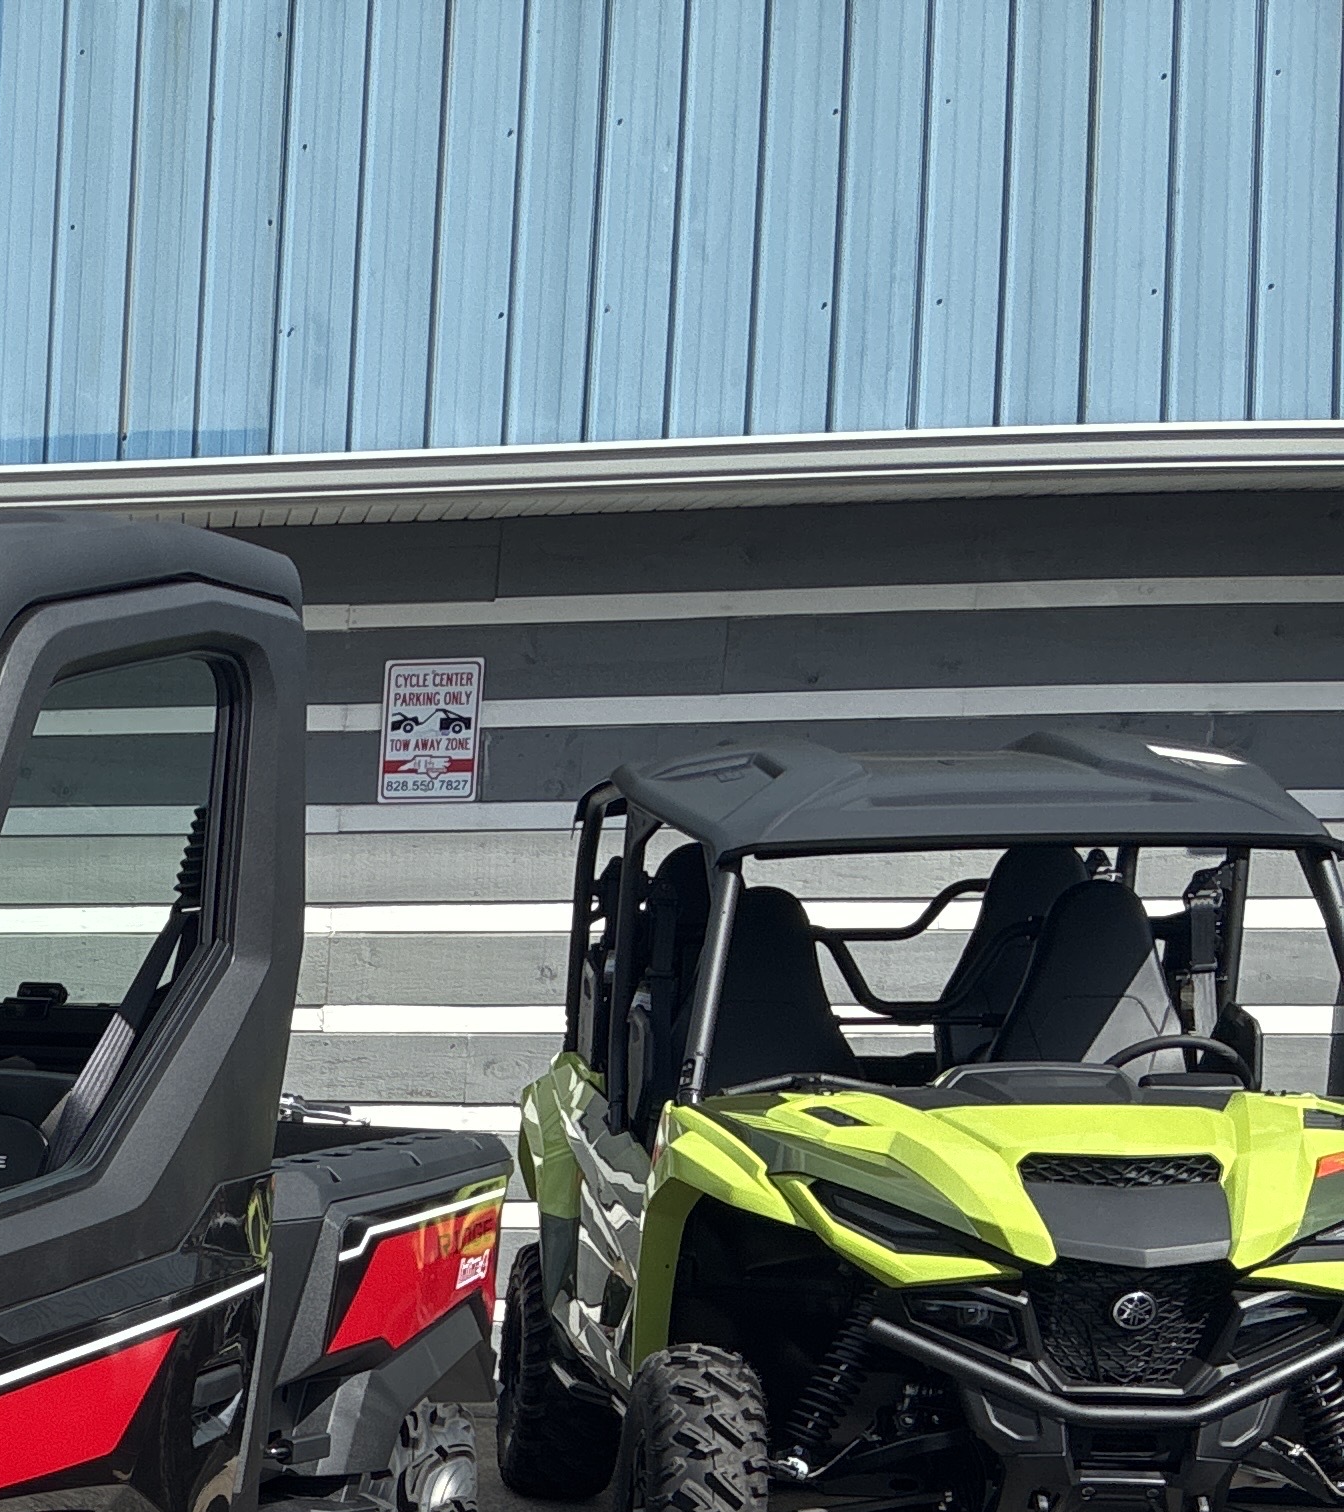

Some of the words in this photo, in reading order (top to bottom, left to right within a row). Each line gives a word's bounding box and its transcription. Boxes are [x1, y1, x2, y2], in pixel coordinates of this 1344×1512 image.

[395, 673, 430, 688] CYCLE
[432, 672, 474, 687] CENTER
[394, 692, 440, 707] PARKING
[444, 691, 472, 705] ONLY
[390, 738, 411, 752] TOW
[414, 738, 443, 751] AWAY
[445, 737, 471, 751] ZONE
[386, 780, 468, 792] 828.550.7827
